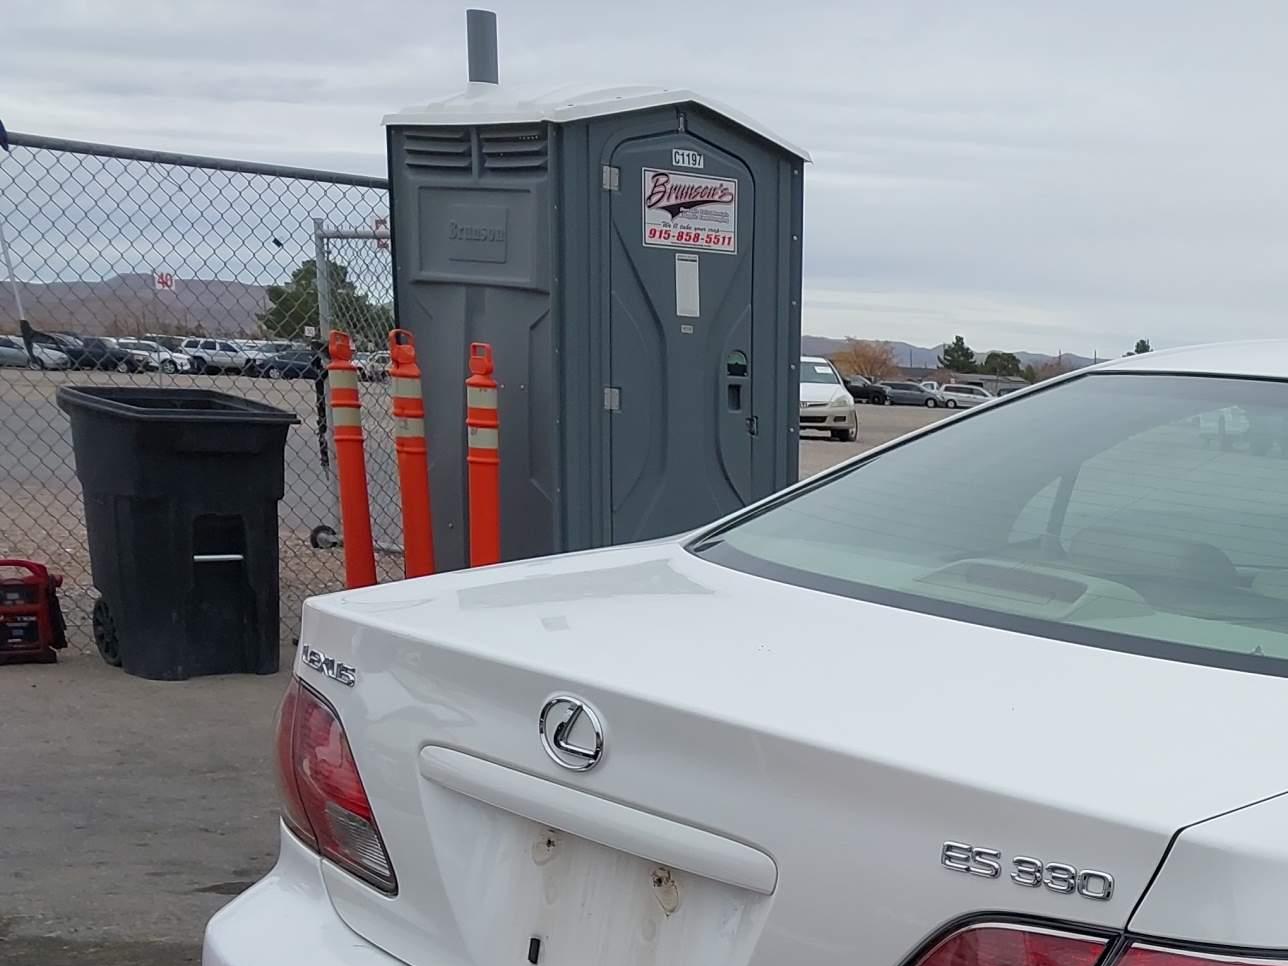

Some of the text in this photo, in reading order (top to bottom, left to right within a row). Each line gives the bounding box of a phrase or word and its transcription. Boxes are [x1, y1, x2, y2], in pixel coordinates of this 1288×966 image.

[673, 150, 703, 167] C1197
[647, 173, 734, 208] Brunson's
[648, 228, 732, 246] 915-858-5511
[302, 643, 357, 688] LEXUS
[941, 839, 1115, 902] ES 330
